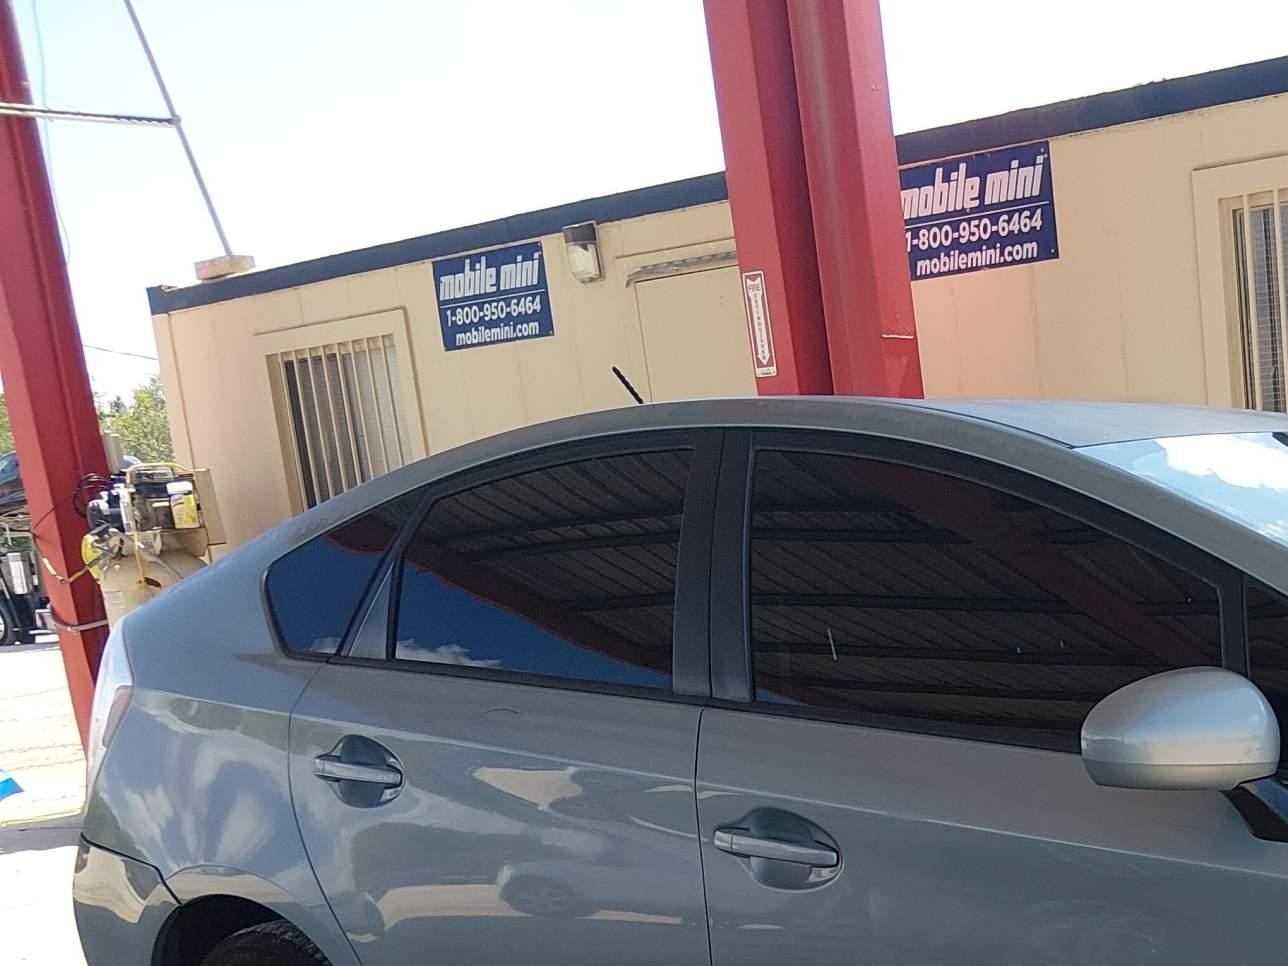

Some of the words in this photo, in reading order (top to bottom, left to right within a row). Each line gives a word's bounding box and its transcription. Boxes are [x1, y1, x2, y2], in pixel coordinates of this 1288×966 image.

[900, 163, 980, 219] mobile
[984, 155, 1044, 206] mini
[905, 208, 1043, 253] 1-800-950-6464
[439, 256, 497, 301] mobile
[500, 252, 541, 291] mini
[916, 241, 1038, 277] mobilemini.com
[446, 295, 541, 327] 1-800-950-6464
[456, 321, 540, 347] mobilemini.com
